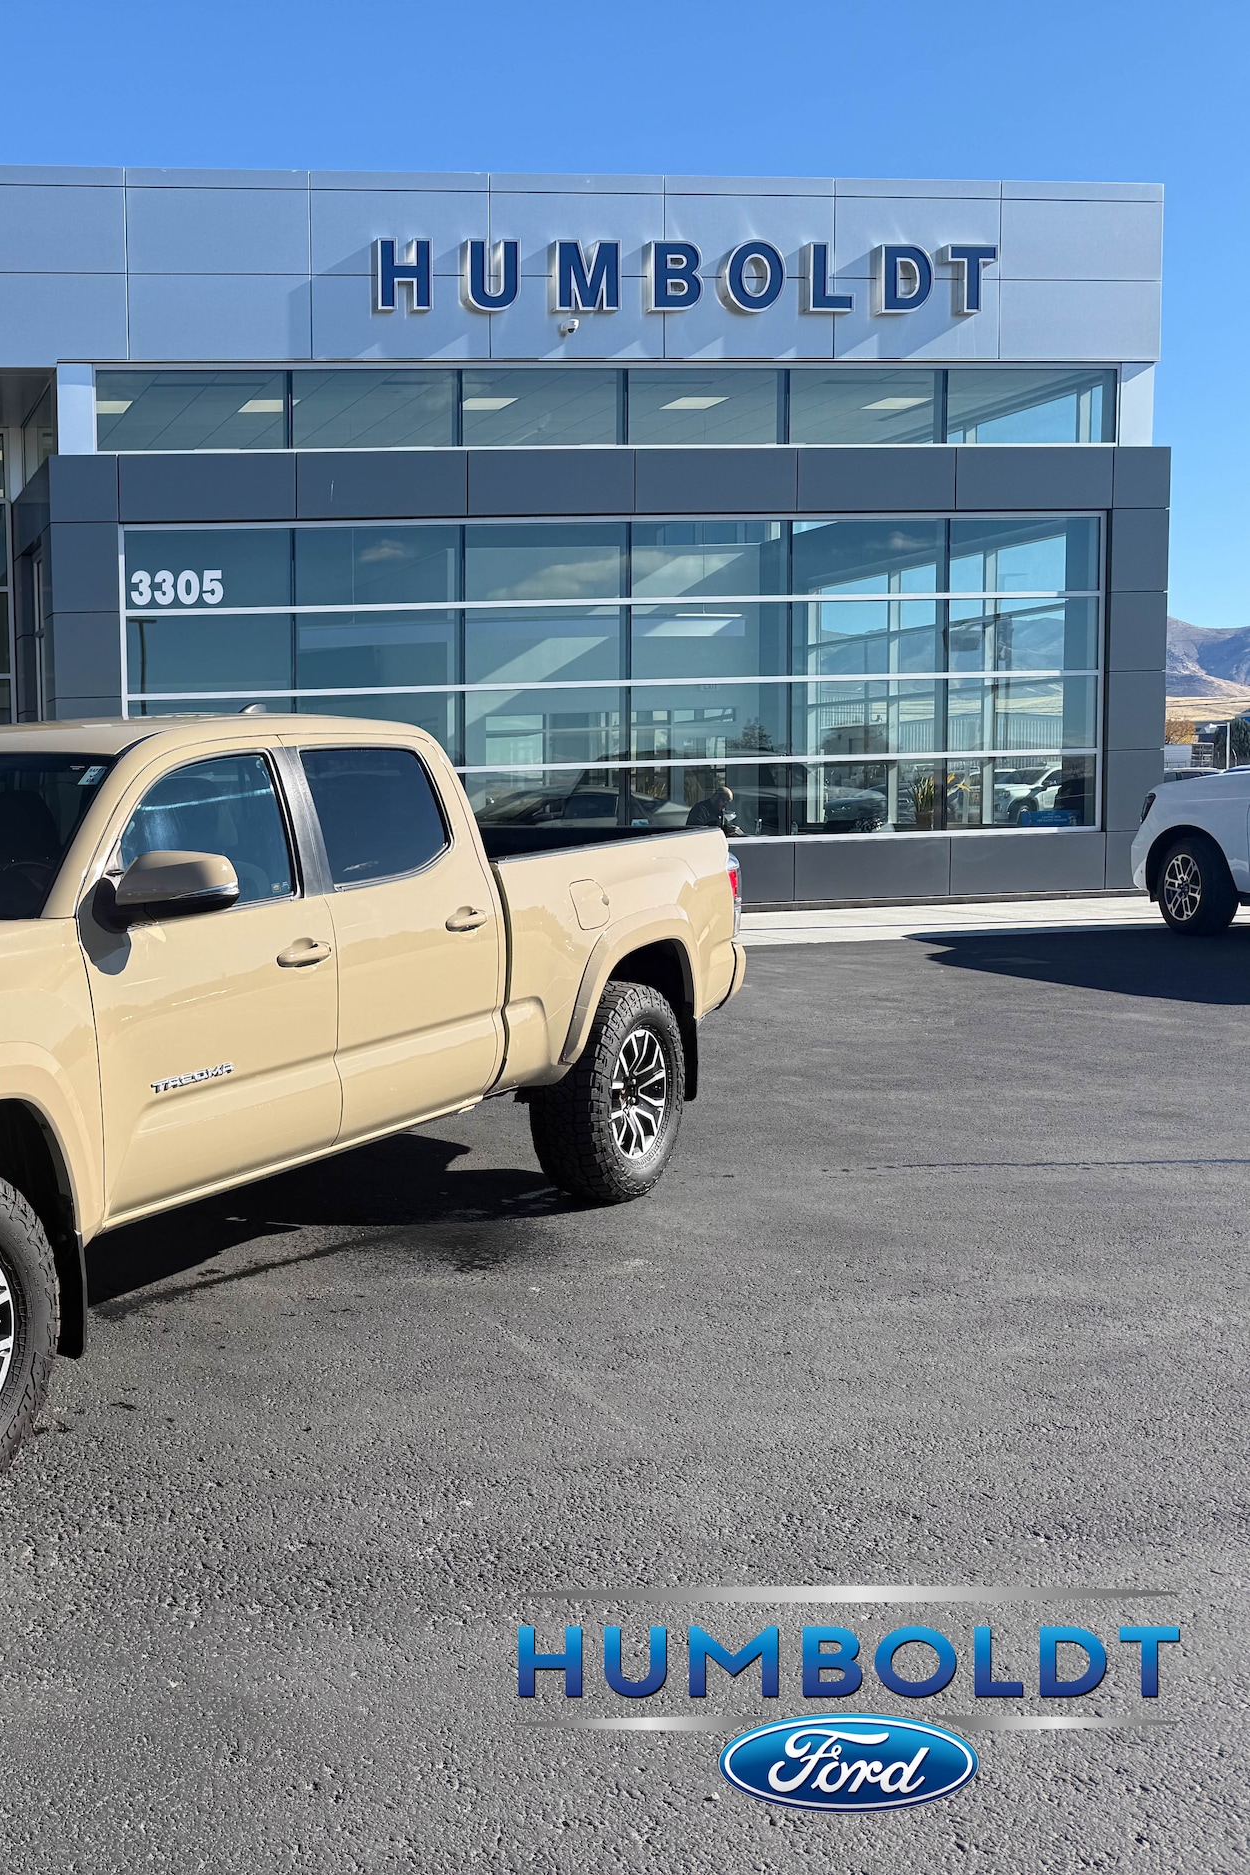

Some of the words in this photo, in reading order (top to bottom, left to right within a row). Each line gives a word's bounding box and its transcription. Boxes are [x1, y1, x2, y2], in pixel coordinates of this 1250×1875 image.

[374, 236, 999, 314] HUMBOLDT
[130, 569, 224, 606] 3305
[150, 1061, 235, 1094] TACOMA
